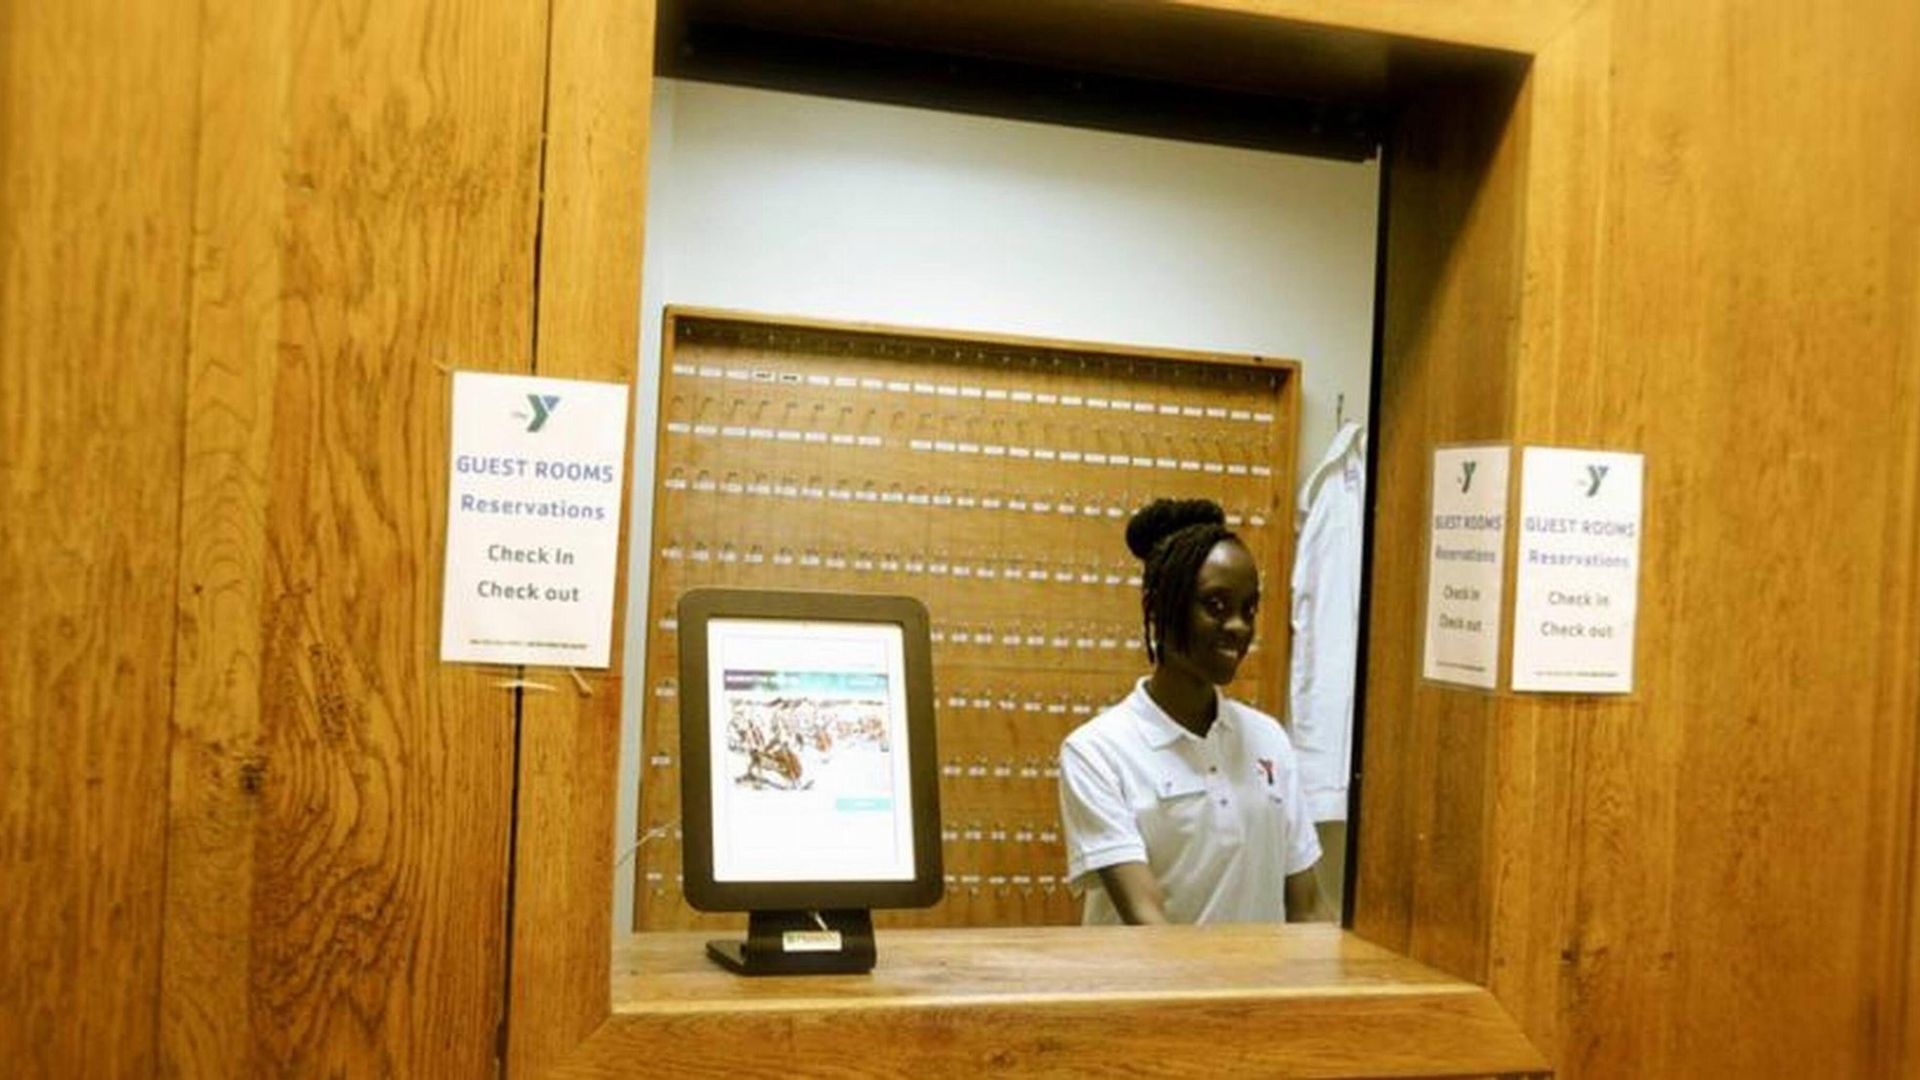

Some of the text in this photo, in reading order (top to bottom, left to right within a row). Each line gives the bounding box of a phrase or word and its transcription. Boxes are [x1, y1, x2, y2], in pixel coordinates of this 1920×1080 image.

[456, 455, 614, 483] GUEST ROOMS
[460, 494, 605, 520] Reservations
[1435, 515, 1501, 532] GUEST ROOMS
[1526, 517, 1635, 537] GUEST ROOMS
[488, 544, 549, 564] Check
[1528, 549, 1630, 569] Reservations
[477, 580, 580, 602] Check out
[1548, 591, 1591, 606] Check
[1540, 621, 1613, 638] Check out
